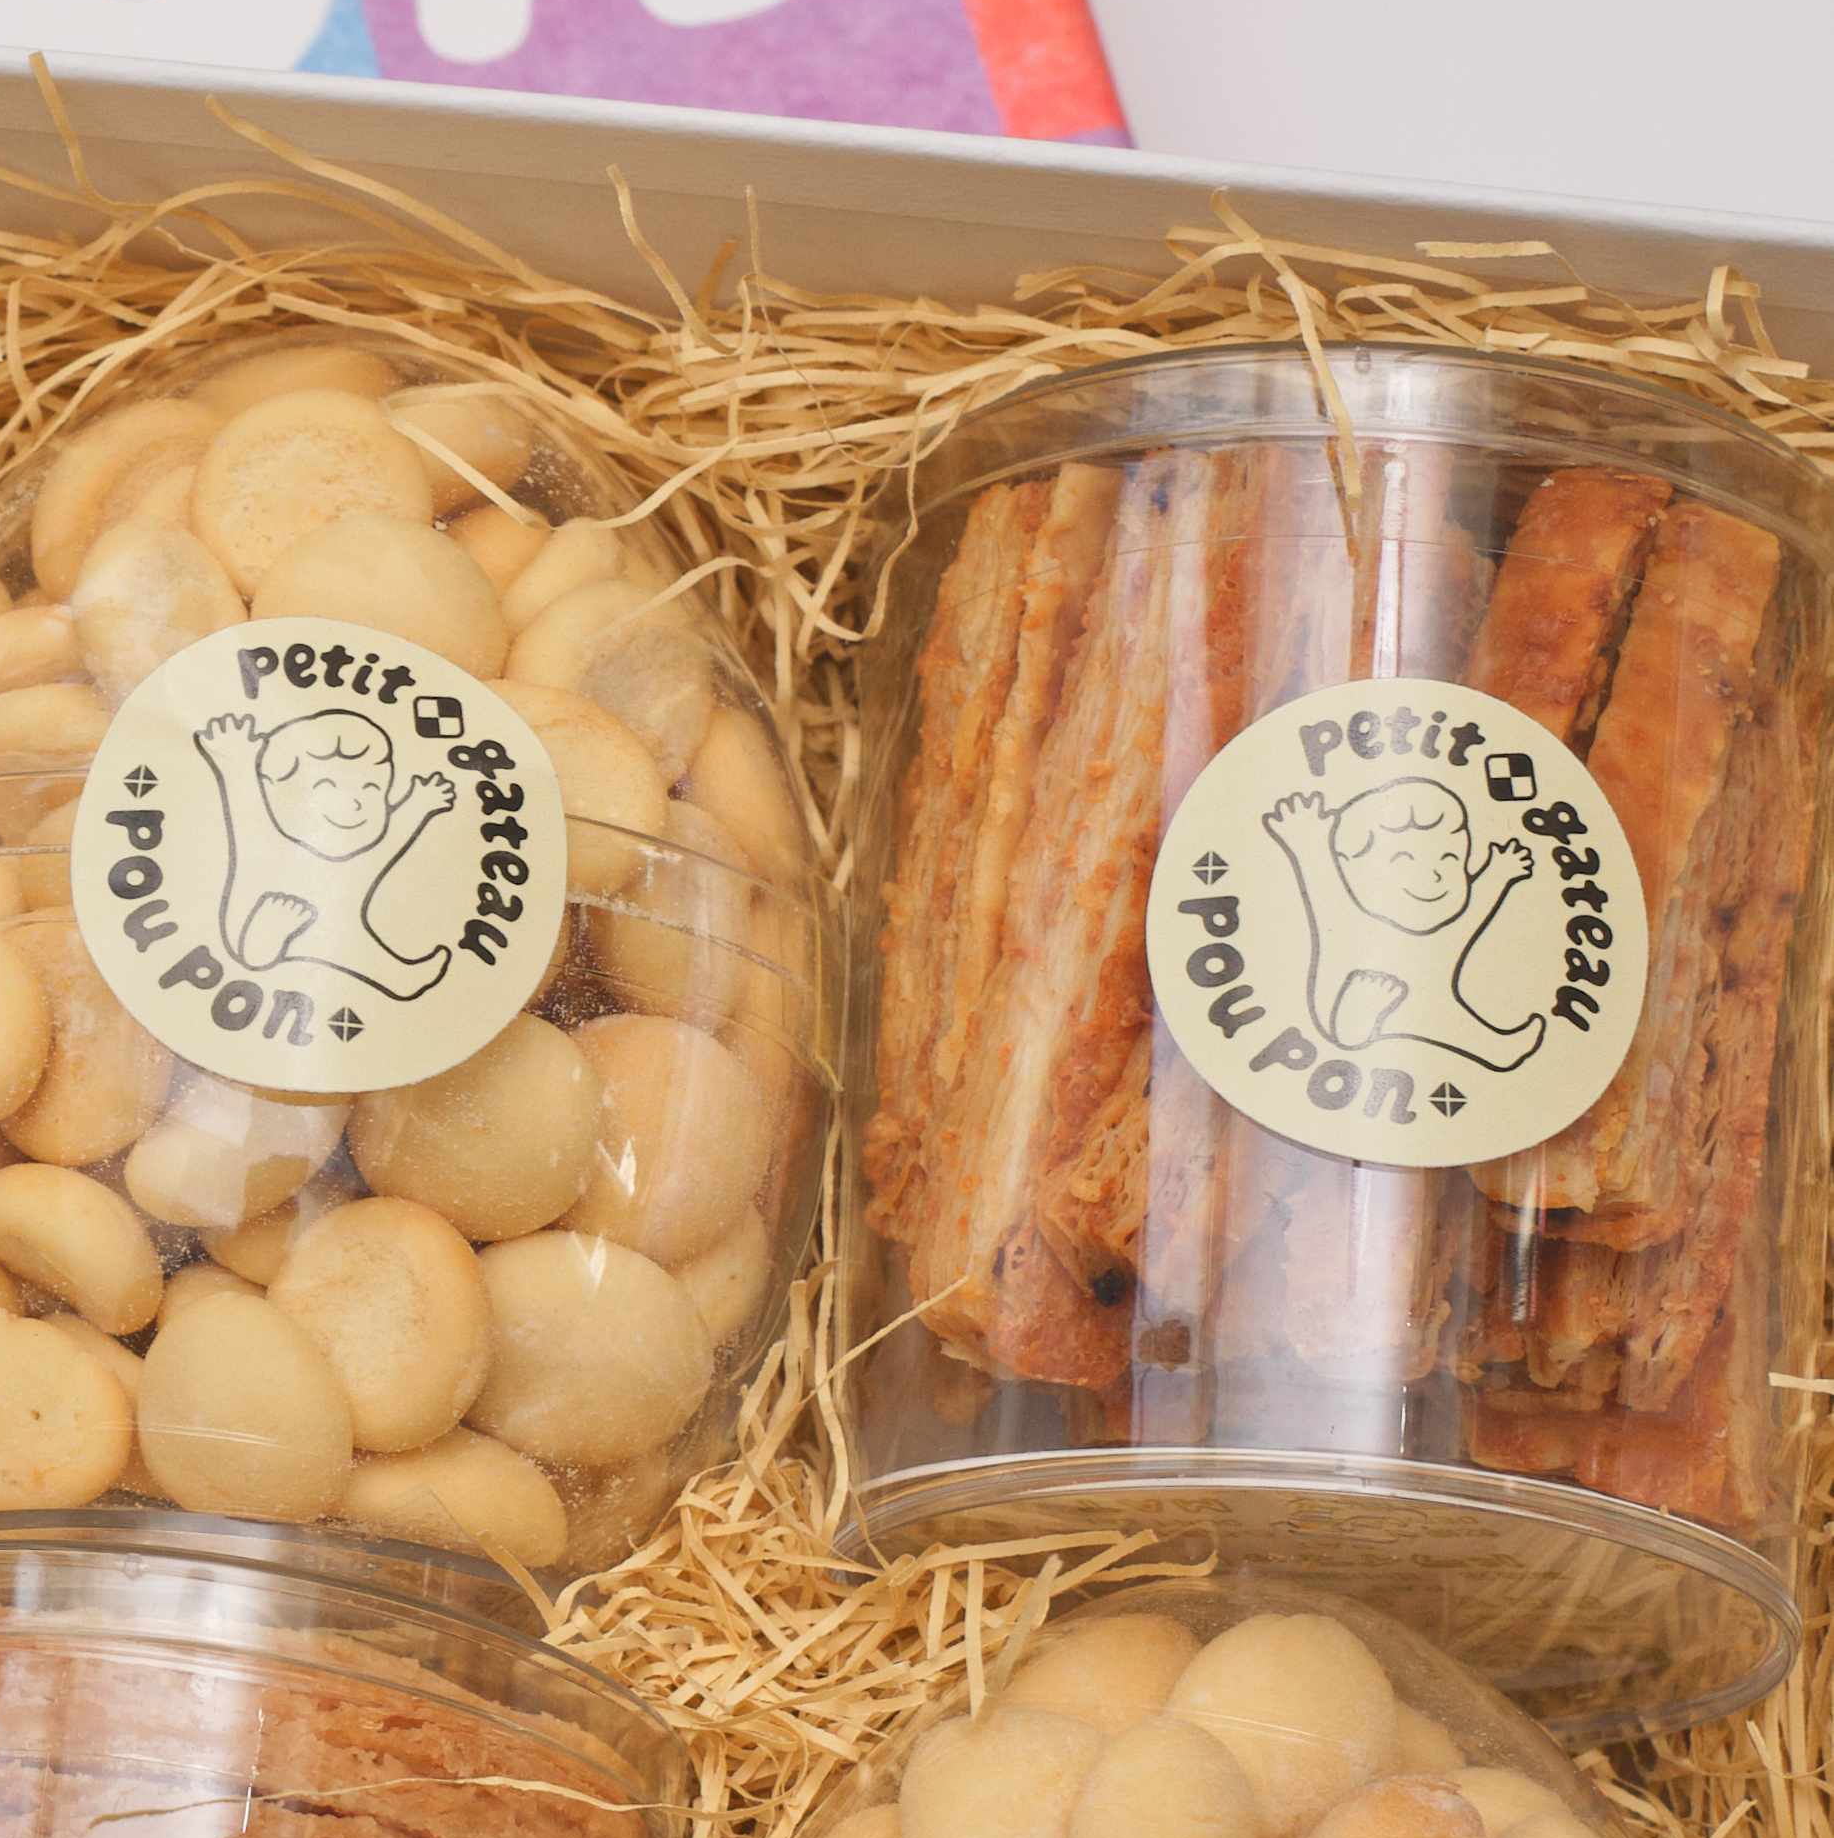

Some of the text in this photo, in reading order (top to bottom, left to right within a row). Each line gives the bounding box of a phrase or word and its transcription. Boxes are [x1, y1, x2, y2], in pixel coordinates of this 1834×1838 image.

[105, 809, 315, 1046] pou pon
[237, 643, 529, 965] petit gateau
[1299, 706, 1614, 1032] petit gateau
[1177, 895, 1417, 1125] pou pon
